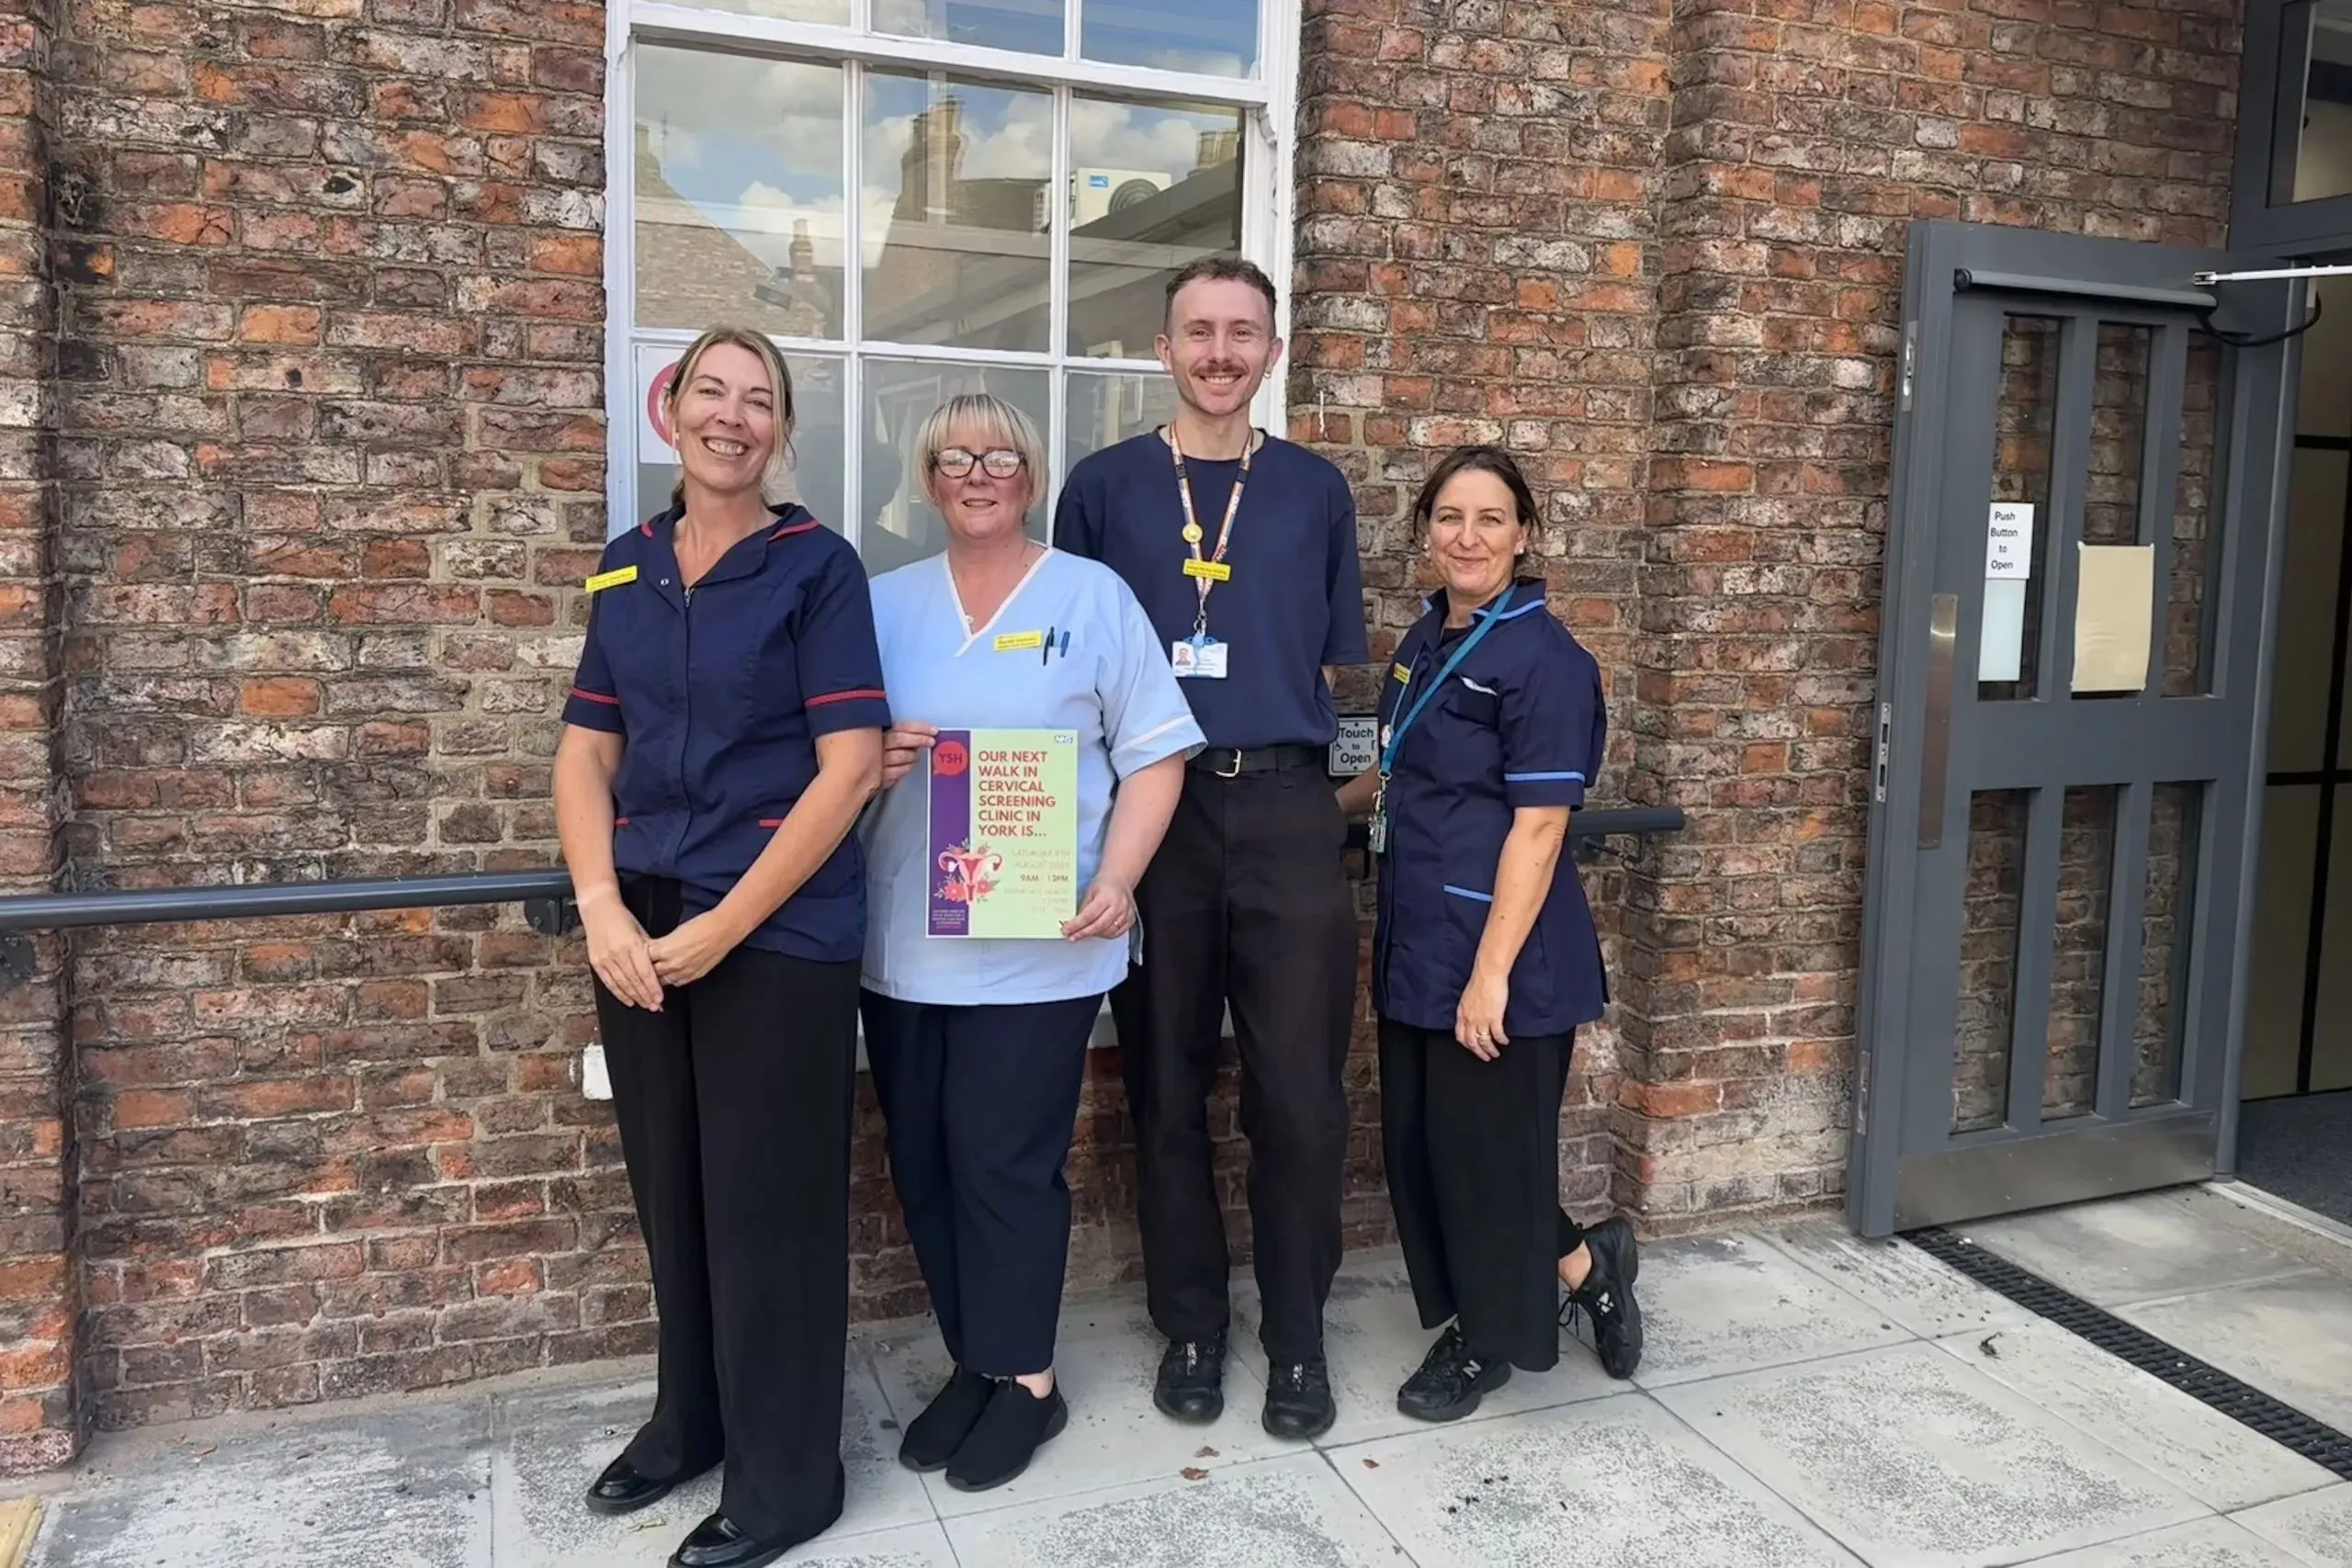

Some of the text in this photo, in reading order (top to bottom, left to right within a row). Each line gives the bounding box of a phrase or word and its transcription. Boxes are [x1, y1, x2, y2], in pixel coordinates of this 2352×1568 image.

[1995, 511, 2016, 521] Push
[1990, 527, 2018, 537] Button
[1999, 545, 2007, 553] to
[1991, 559, 2014, 570] Open
[1338, 728, 1374, 739] Touch
[938, 752, 963, 763] YSH
[978, 750, 1048, 762] OUR NEXT
[1340, 752, 1371, 766] Open
[978, 765, 1038, 777] WALK IN
[978, 780, 1045, 793] CERVICAL
[978, 795, 1057, 807] SCREENING
[978, 810, 1041, 822] CLINIC IN
[978, 825, 1047, 837] YORK IS...
[1020, 874, 1040, 882] 9AM
